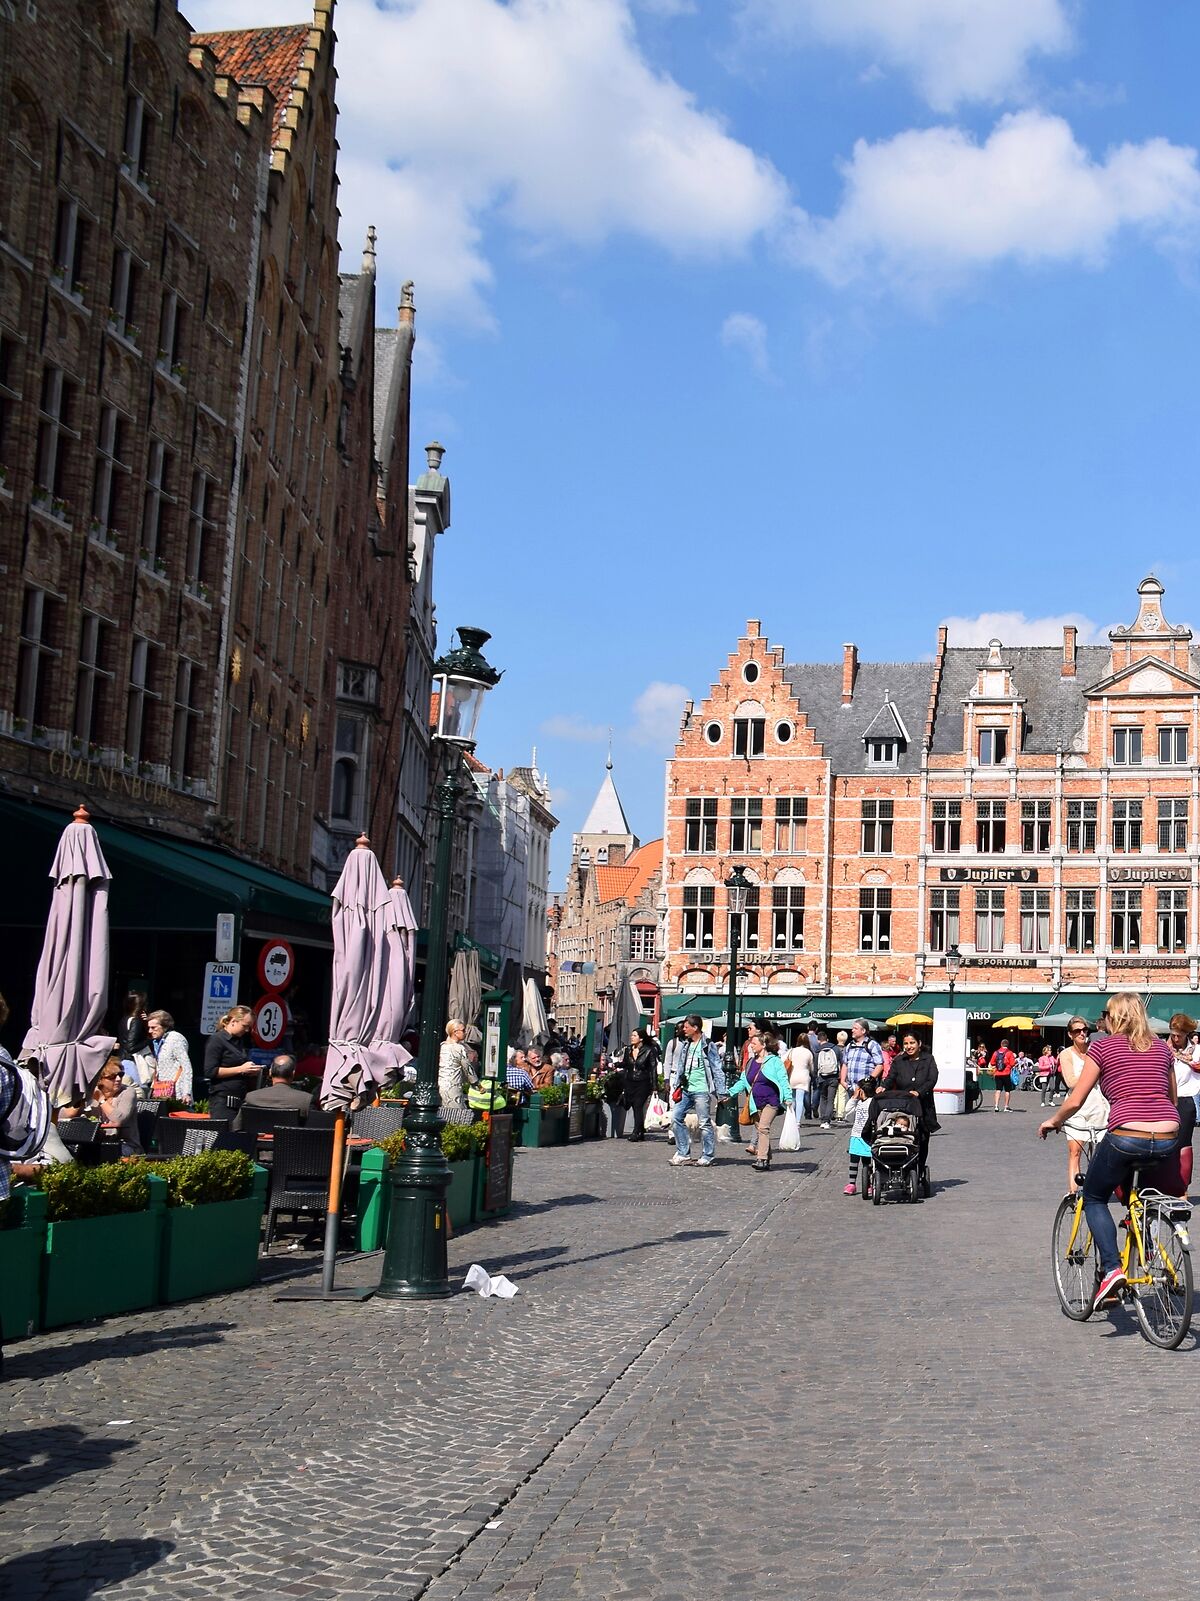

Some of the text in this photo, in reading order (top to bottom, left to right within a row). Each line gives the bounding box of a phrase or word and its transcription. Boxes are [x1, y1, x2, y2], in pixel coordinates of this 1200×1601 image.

[964, 868, 1015, 885] Jupiler
[1124, 868, 1177, 885] Jupiler
[703, 953, 721, 964] DE
[977, 958, 1030, 967] SPORTMAN
[1109, 959, 1134, 967] CAFE
[212, 964, 235, 974] ZONE
[763, 1010, 775, 1018] De
[776, 1010, 802, 1018] Beurze
[809, 1010, 838, 1018] Tearoom
[966, 1011, 991, 1020] ARIO
